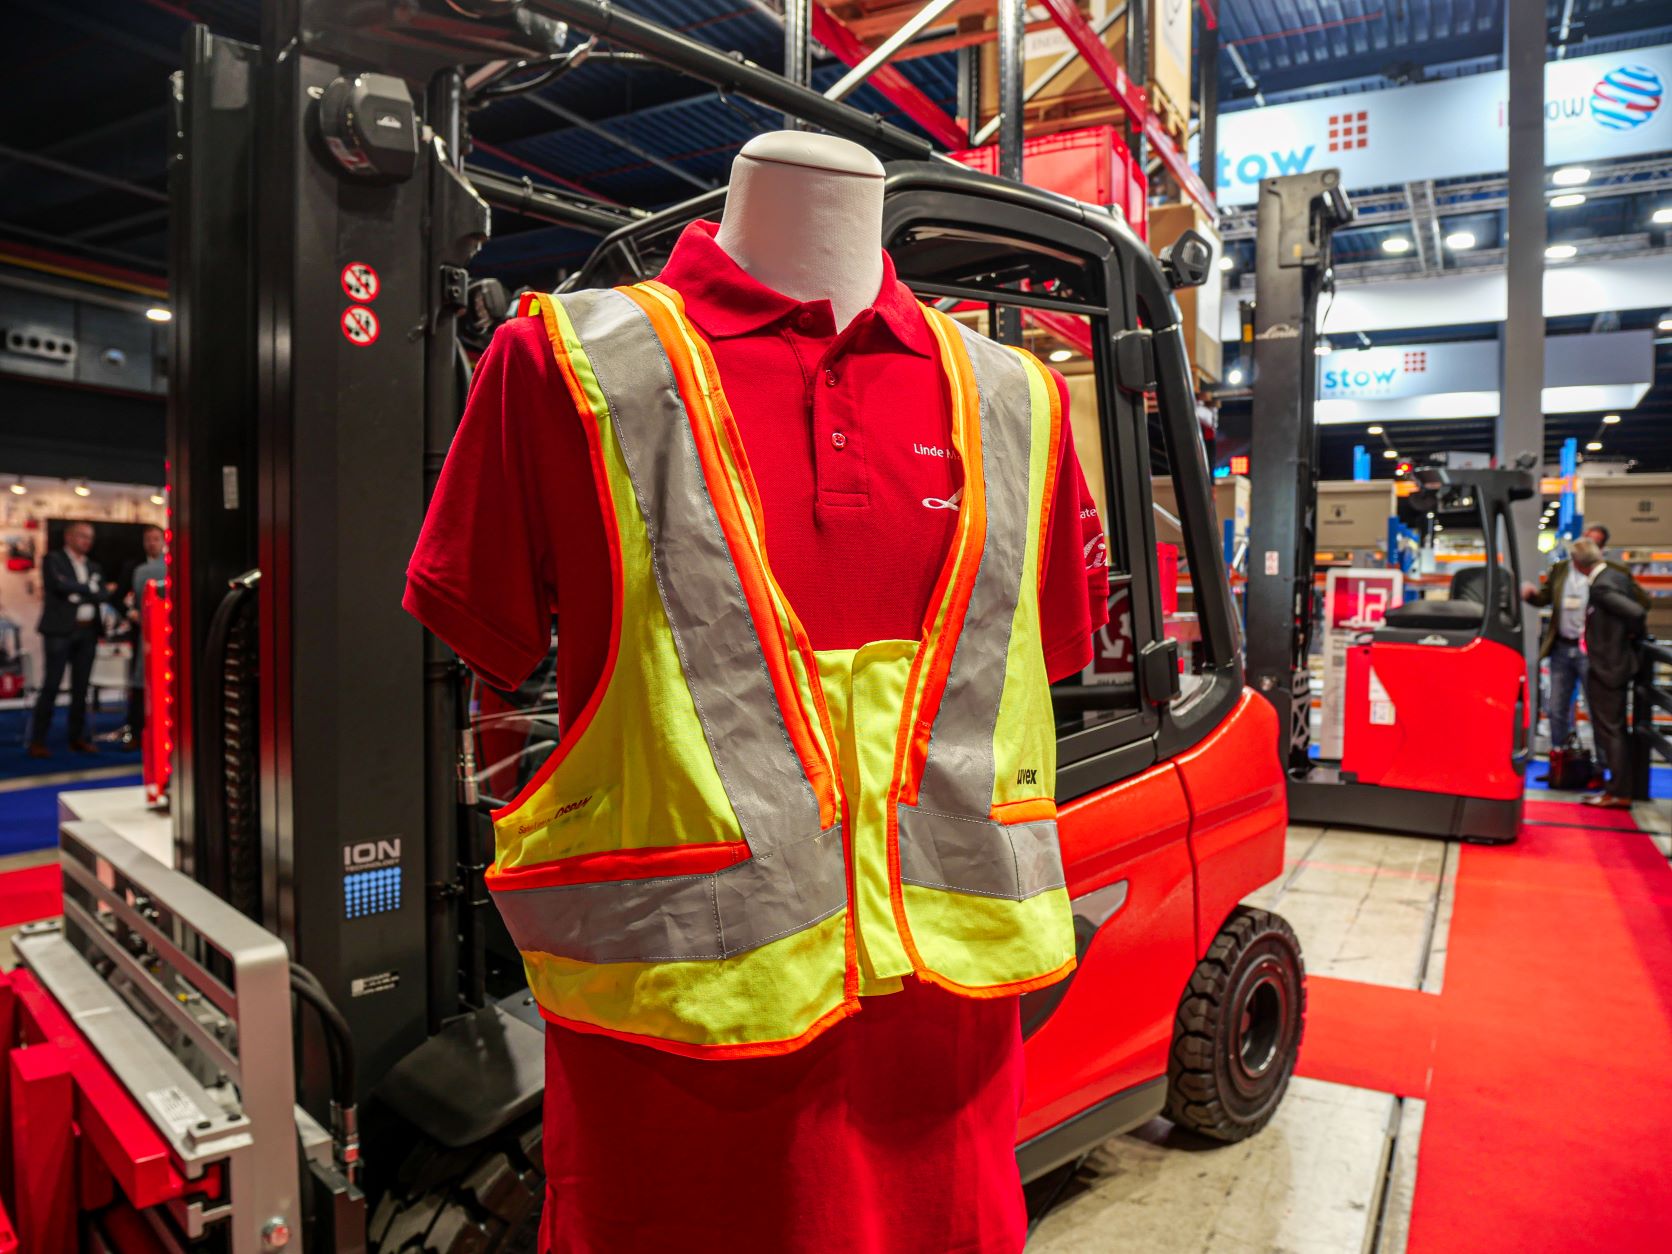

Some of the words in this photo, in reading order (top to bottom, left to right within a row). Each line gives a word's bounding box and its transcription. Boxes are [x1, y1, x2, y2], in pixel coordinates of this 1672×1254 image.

[1190, 144, 1315, 188] tow
[1325, 368, 1396, 388] stow
[913, 443, 944, 457] Linde
[1080, 508, 1097, 518] ate
[343, 838, 401, 866] ION
